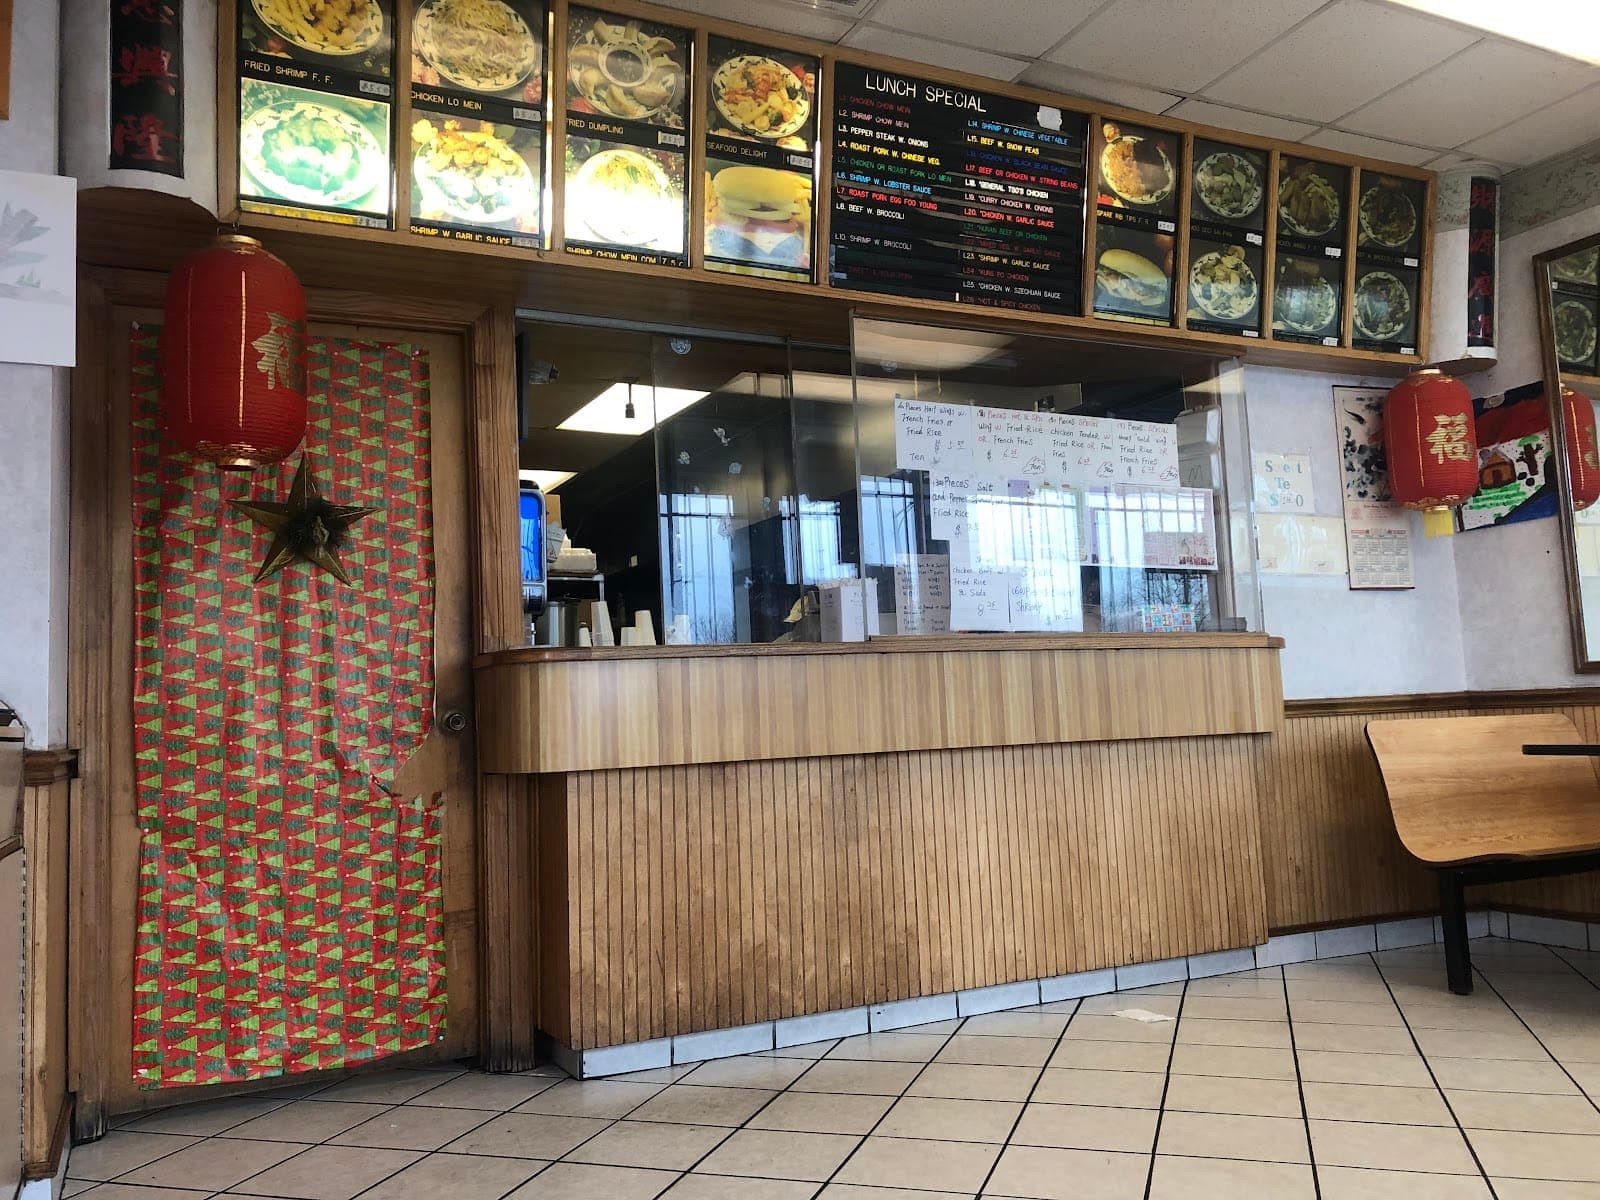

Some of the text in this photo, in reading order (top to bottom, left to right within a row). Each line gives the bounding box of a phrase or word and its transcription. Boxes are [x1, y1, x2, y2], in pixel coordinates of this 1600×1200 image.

[244, 60, 334, 85] FRIED SHRIMP F. F.
[411, 91, 482, 110] CHICKEN LO MEIN
[865, 72, 987, 113] LUNCH SPECIAL
[850, 95, 911, 114] CHICKEN CHOW MEIN
[838, 108, 910, 129] L2. SHRIMP CHOW MEIN
[589, 122, 624, 134] DUMPLING
[838, 123, 929, 149] L3. PEPPER STEAK W. ONIONS
[981, 122, 1002, 133] SHRIMP
[1013, 128, 1035, 139] CHINESE
[1038, 132, 1069, 145] VEGETABLE
[707, 142, 768, 158] SEAFOOD DELIGHT
[838, 139, 848, 148] L4.
[850, 141, 870, 153] ROAST
[873, 145, 889, 157] PORK
[901, 151, 926, 163] CHINESE
[980, 136, 995, 146] BEEF
[1006, 142, 1023, 152] SNOW
[1024, 146, 1040, 155] PEAS
[850, 158, 874, 169] CHICKEN
[877, 163, 885, 171] OR
[887, 164, 907, 175] ROAST
[910, 168, 925, 178] PORK
[927, 171, 936, 180] LO
[938, 173, 952, 183] MEIN
[978, 166, 993, 175] BEEF
[1006, 170, 1029, 182] CHICKEN
[1039, 176, 1059, 187] STRING
[1060, 180, 1079, 190] BEANS
[836, 171, 846, 179] L6.
[849, 173, 871, 184] SHRIMP
[883, 179, 910, 191] LOBSTER
[912, 184, 933, 195] SAUCE
[836, 187, 938, 211] L7. ROAST PORK EGG FOO YOUNG
[1026, 188, 1049, 200] CHICKEN
[836, 202, 905, 220] L8. BEEF W. BROCCOLI
[1000, 199, 1023, 209] CHICKEN
[1034, 204, 1054, 214] ONIONS
[1015, 216, 1035, 226] GARLIC
[1037, 220, 1056, 229] SAUCE
[410, 225, 439, 237] SHRIMP
[1000, 228, 1013, 236] BEEF
[1026, 232, 1048, 241] CHICKEN
[850, 234, 872, 244] SHRIMP
[883, 240, 912, 250] BROCCOLI
[1011, 259, 1031, 268] GARLIC
[1032, 262, 1051, 271] SAUCE
[1007, 272, 1030, 282] CHICKEN
[1014, 287, 1042, 297] SZECHUAN
[1044, 290, 1062, 299] SAUCE
[1019, 302, 1040, 310] CHICKEN
[901, 413, 923, 422] French
[906, 426, 942, 436] Fried Rice
[1007, 423, 1043, 433] Fried Rice
[993, 434, 1013, 445] French
[944, 476, 993, 492] Pieces Salt
[934, 507, 951, 517] Fried
[954, 578, 969, 586] Fried
